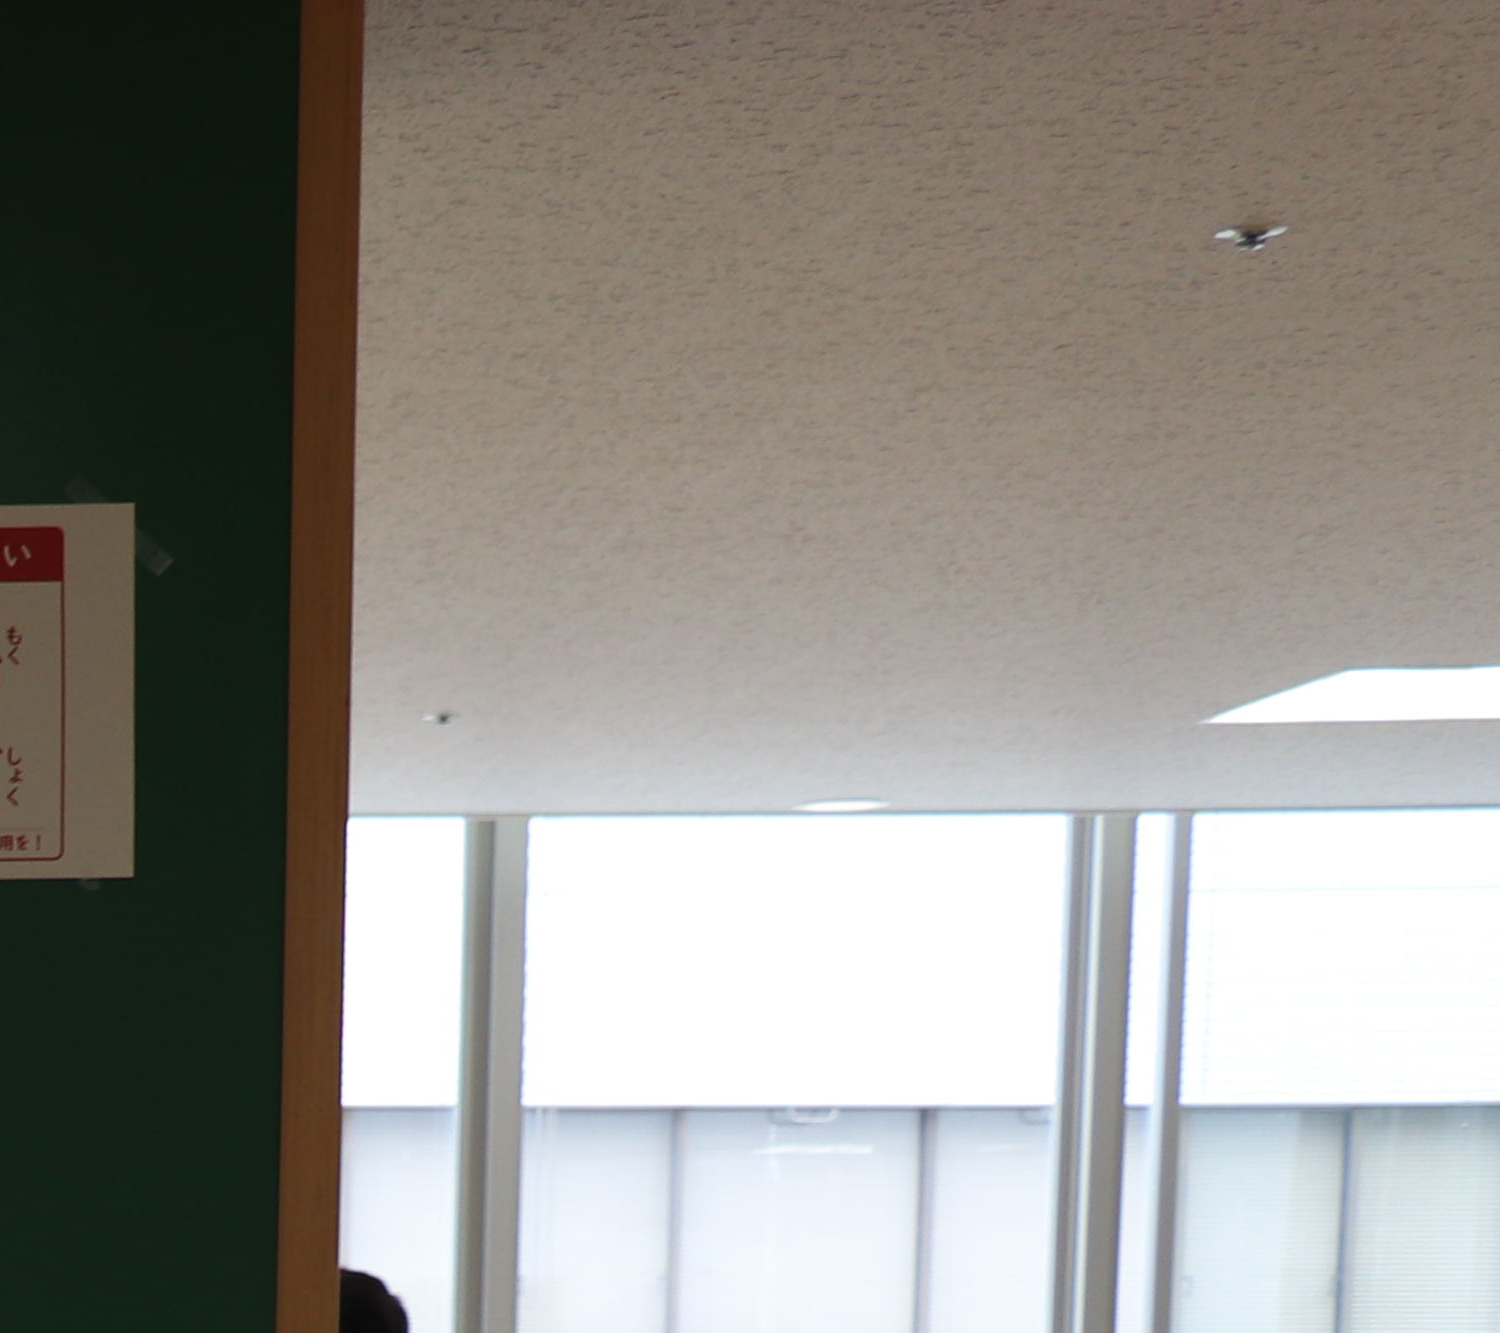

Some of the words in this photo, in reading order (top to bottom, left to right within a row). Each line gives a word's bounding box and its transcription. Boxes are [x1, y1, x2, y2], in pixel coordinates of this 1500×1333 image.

[4, 625, 23, 666] もく
[5, 747, 24, 807] しょく
